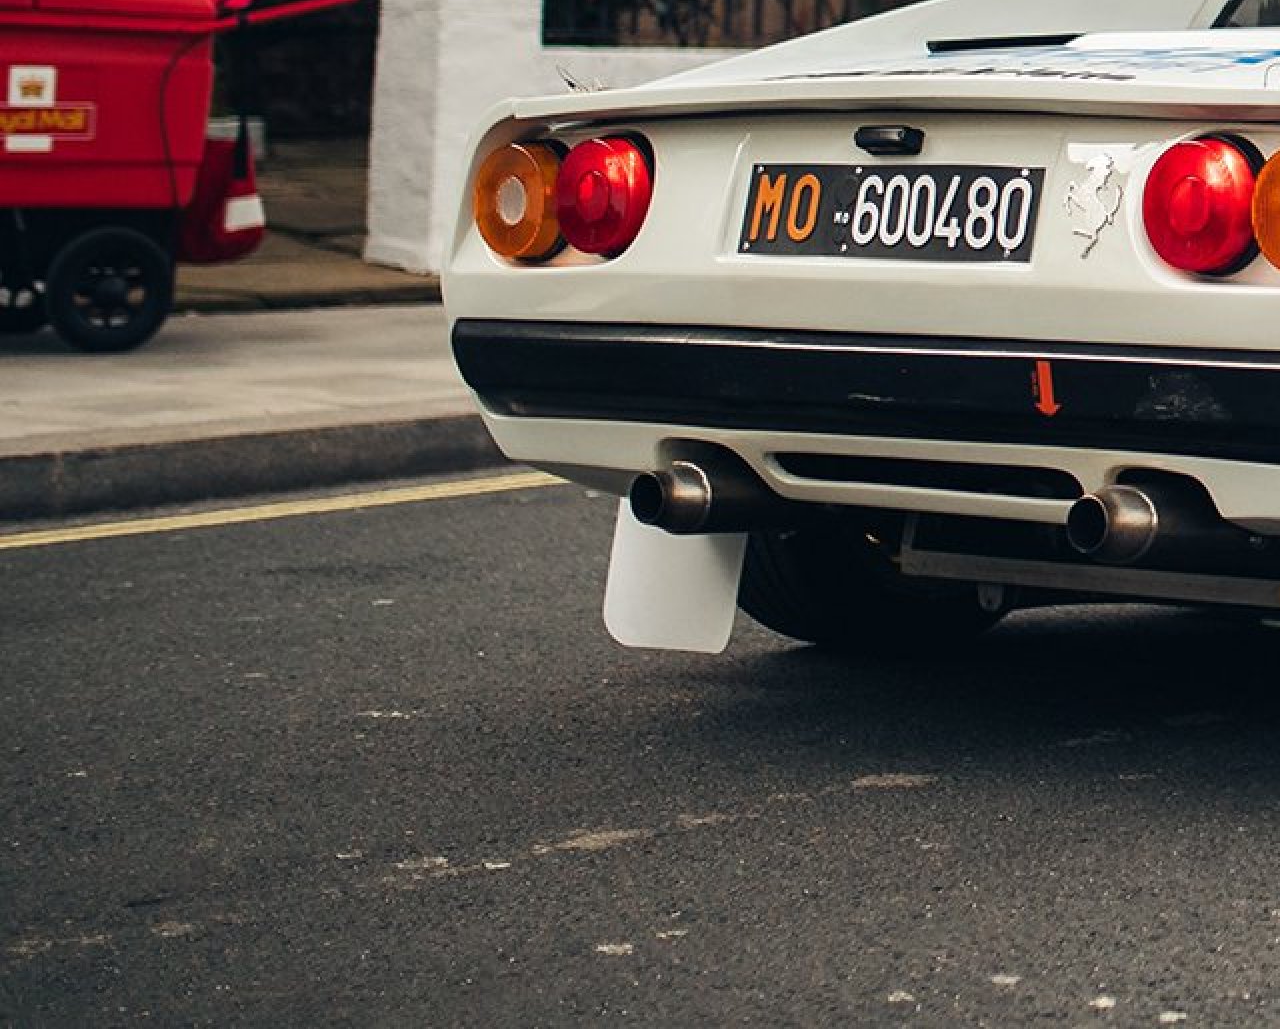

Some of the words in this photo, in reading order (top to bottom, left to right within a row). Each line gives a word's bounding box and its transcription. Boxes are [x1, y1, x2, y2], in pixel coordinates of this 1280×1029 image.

[0, 108, 36, 132] yal
[749, 174, 821, 242] MO
[852, 174, 1032, 250] 600480
